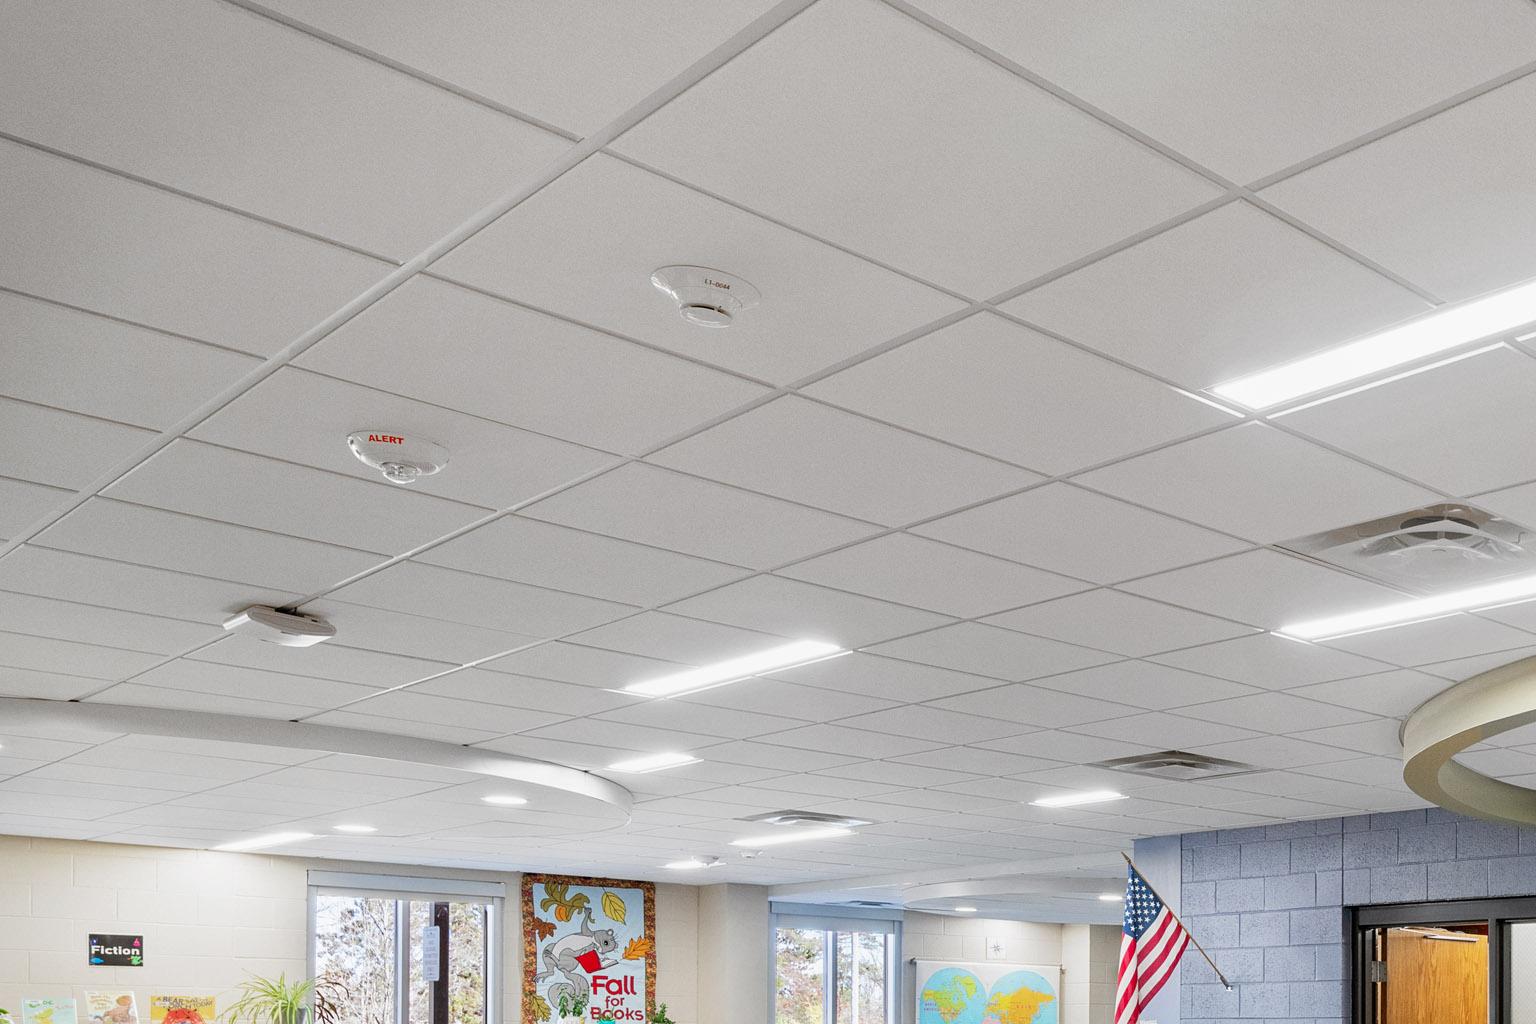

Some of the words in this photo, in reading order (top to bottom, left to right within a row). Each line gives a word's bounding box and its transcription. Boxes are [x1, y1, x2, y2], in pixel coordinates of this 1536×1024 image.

[368, 434, 404, 445] ALERT
[91, 944, 140, 956] Fiction
[591, 976, 637, 996] Fall
[605, 996, 625, 1008] for
[590, 1007, 644, 1021] Books
